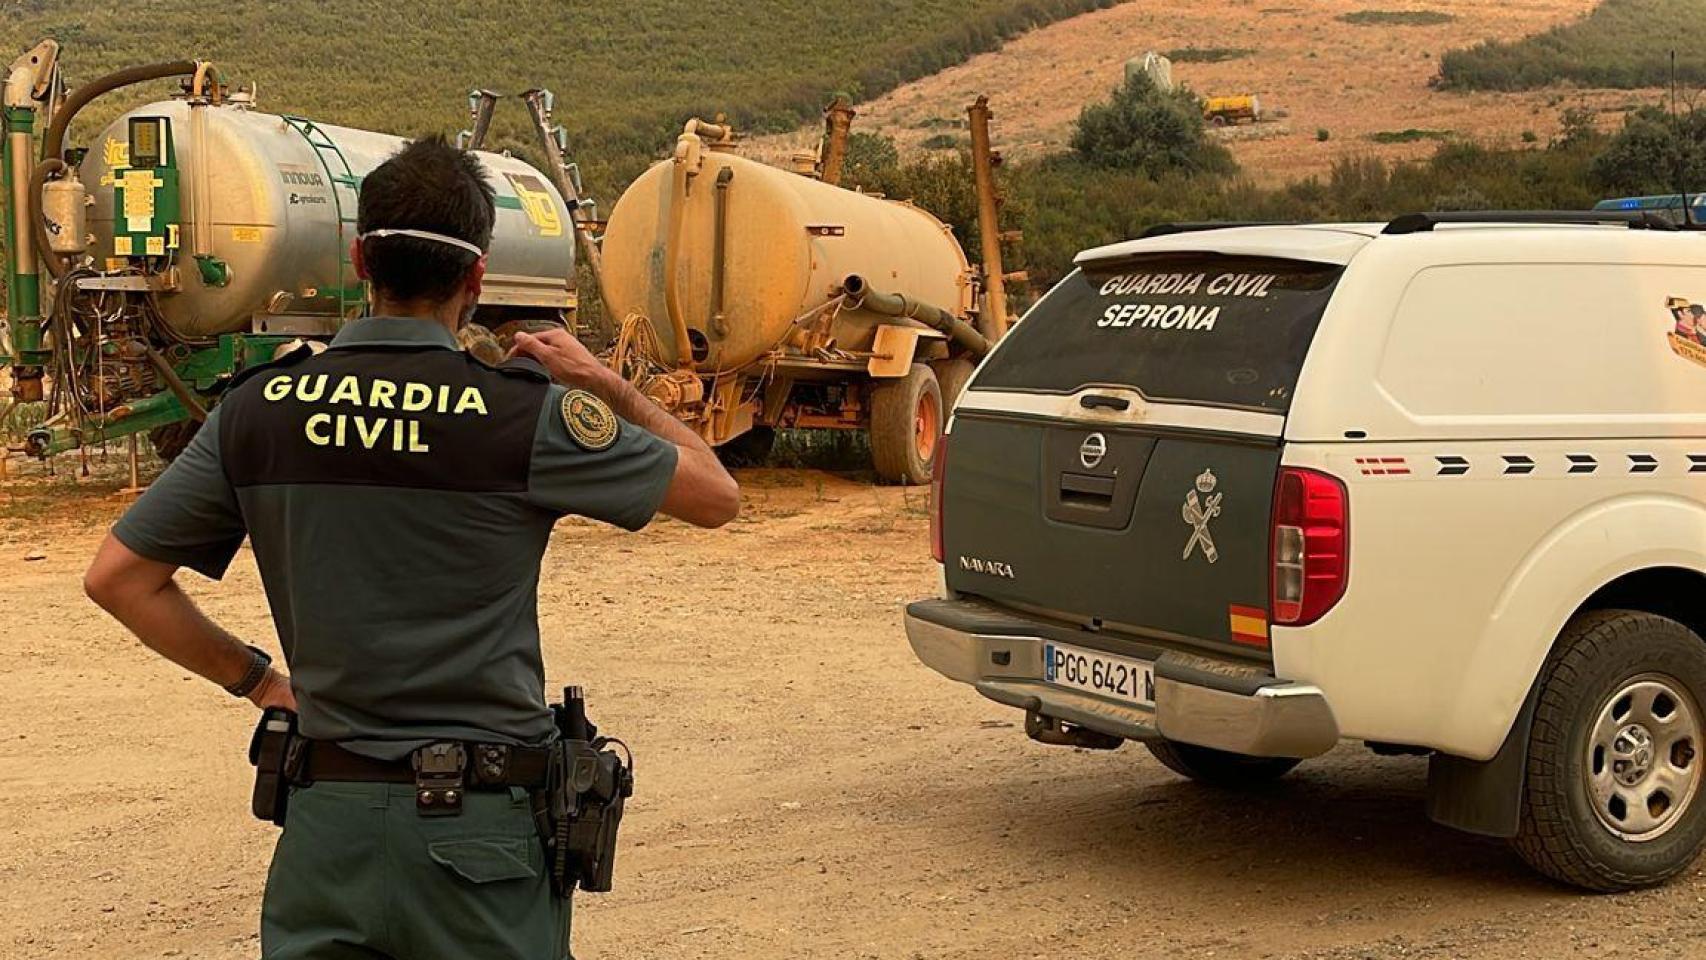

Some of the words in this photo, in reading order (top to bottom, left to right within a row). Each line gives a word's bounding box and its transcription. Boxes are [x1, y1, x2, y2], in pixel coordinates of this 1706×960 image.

[1099, 273, 1205, 296] GUARDIA
[1206, 273, 1276, 297] CIVIL
[1097, 304, 1221, 331] SEPRONA
[263, 374, 488, 415] GUARDIA
[304, 413, 430, 453] CIVIL
[960, 556, 1015, 579] NAVARA
[1055, 650, 1088, 685] PGC
[1092, 658, 1137, 698] 6421
